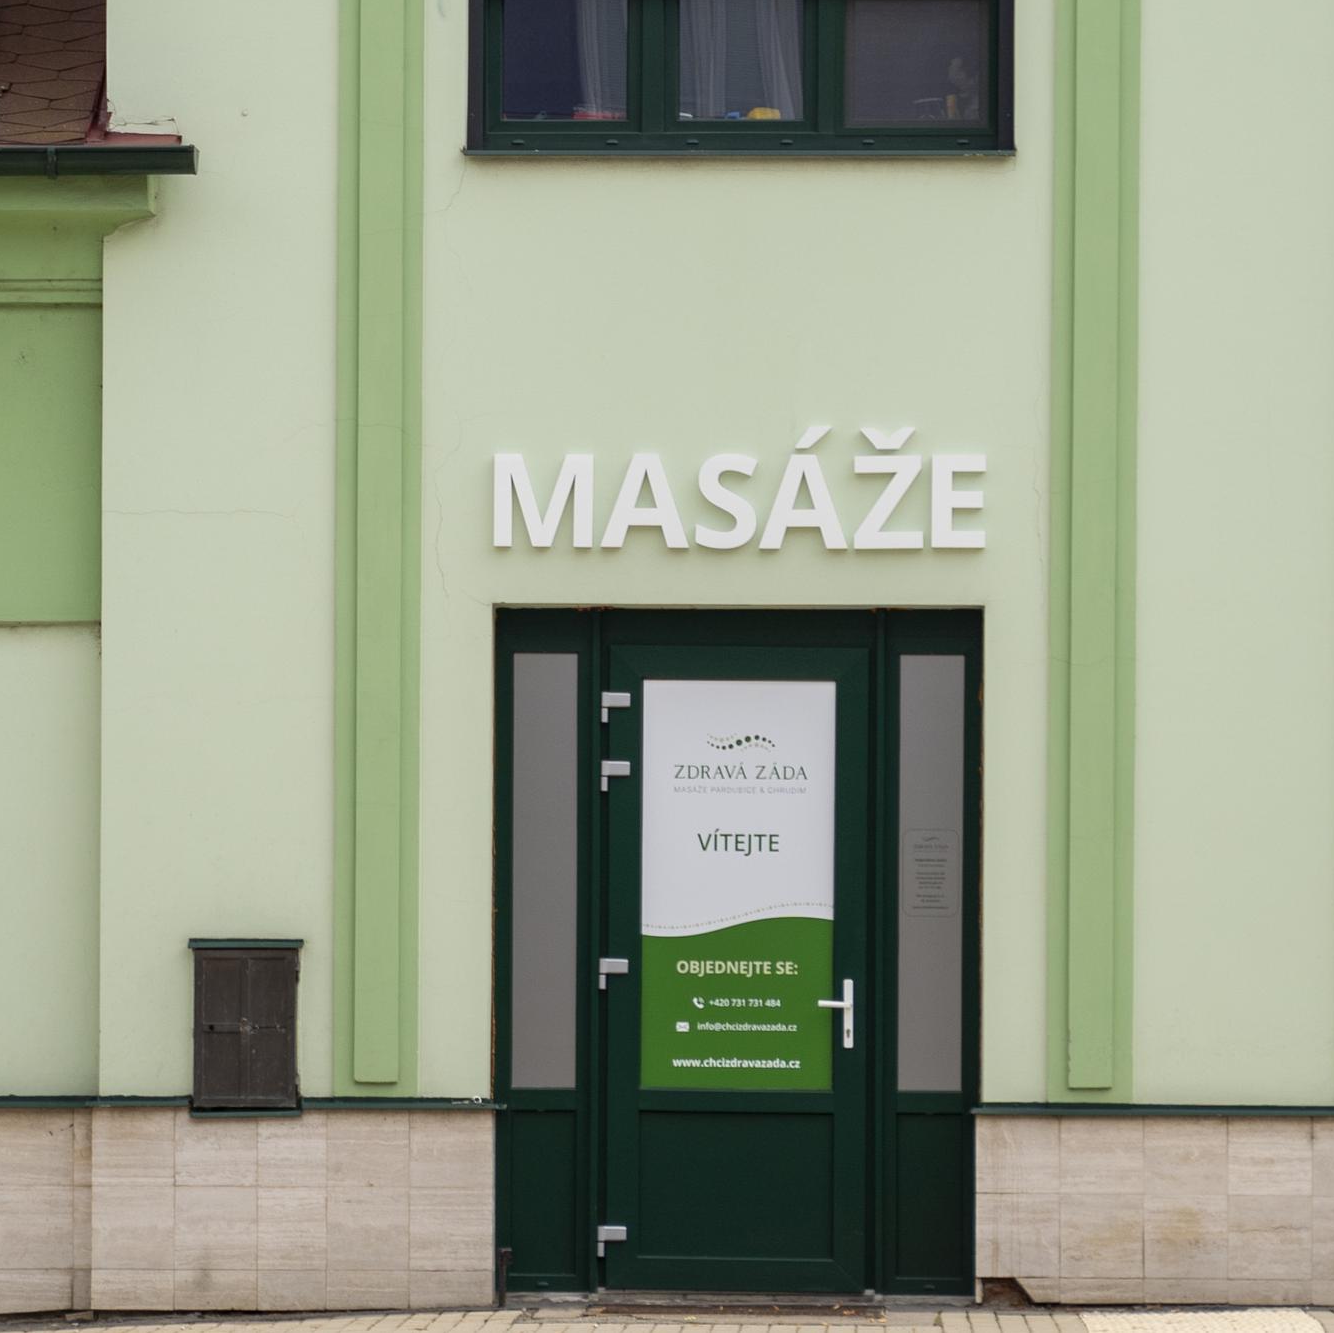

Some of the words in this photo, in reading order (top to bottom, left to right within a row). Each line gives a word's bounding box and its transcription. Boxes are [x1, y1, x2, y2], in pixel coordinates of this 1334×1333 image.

[493, 425, 987, 549] MASÁŽE
[674, 762, 747, 779] ZDRAVÁ
[755, 763, 808, 780] ZÁDA
[697, 828, 779, 856] VÍTEJTE
[677, 960, 771, 977] OBJEDNEJTE
[776, 961, 798, 975] SE:
[709, 999, 729, 1007] +420
[731, 999, 745, 1007] 731
[749, 999, 763, 1007] 731
[765, 999, 781, 1007] 484
[697, 1022, 797, 1031] info@chcizdravazada.cz
[672, 1057, 800, 1068] www.chcizdravazada.cz
